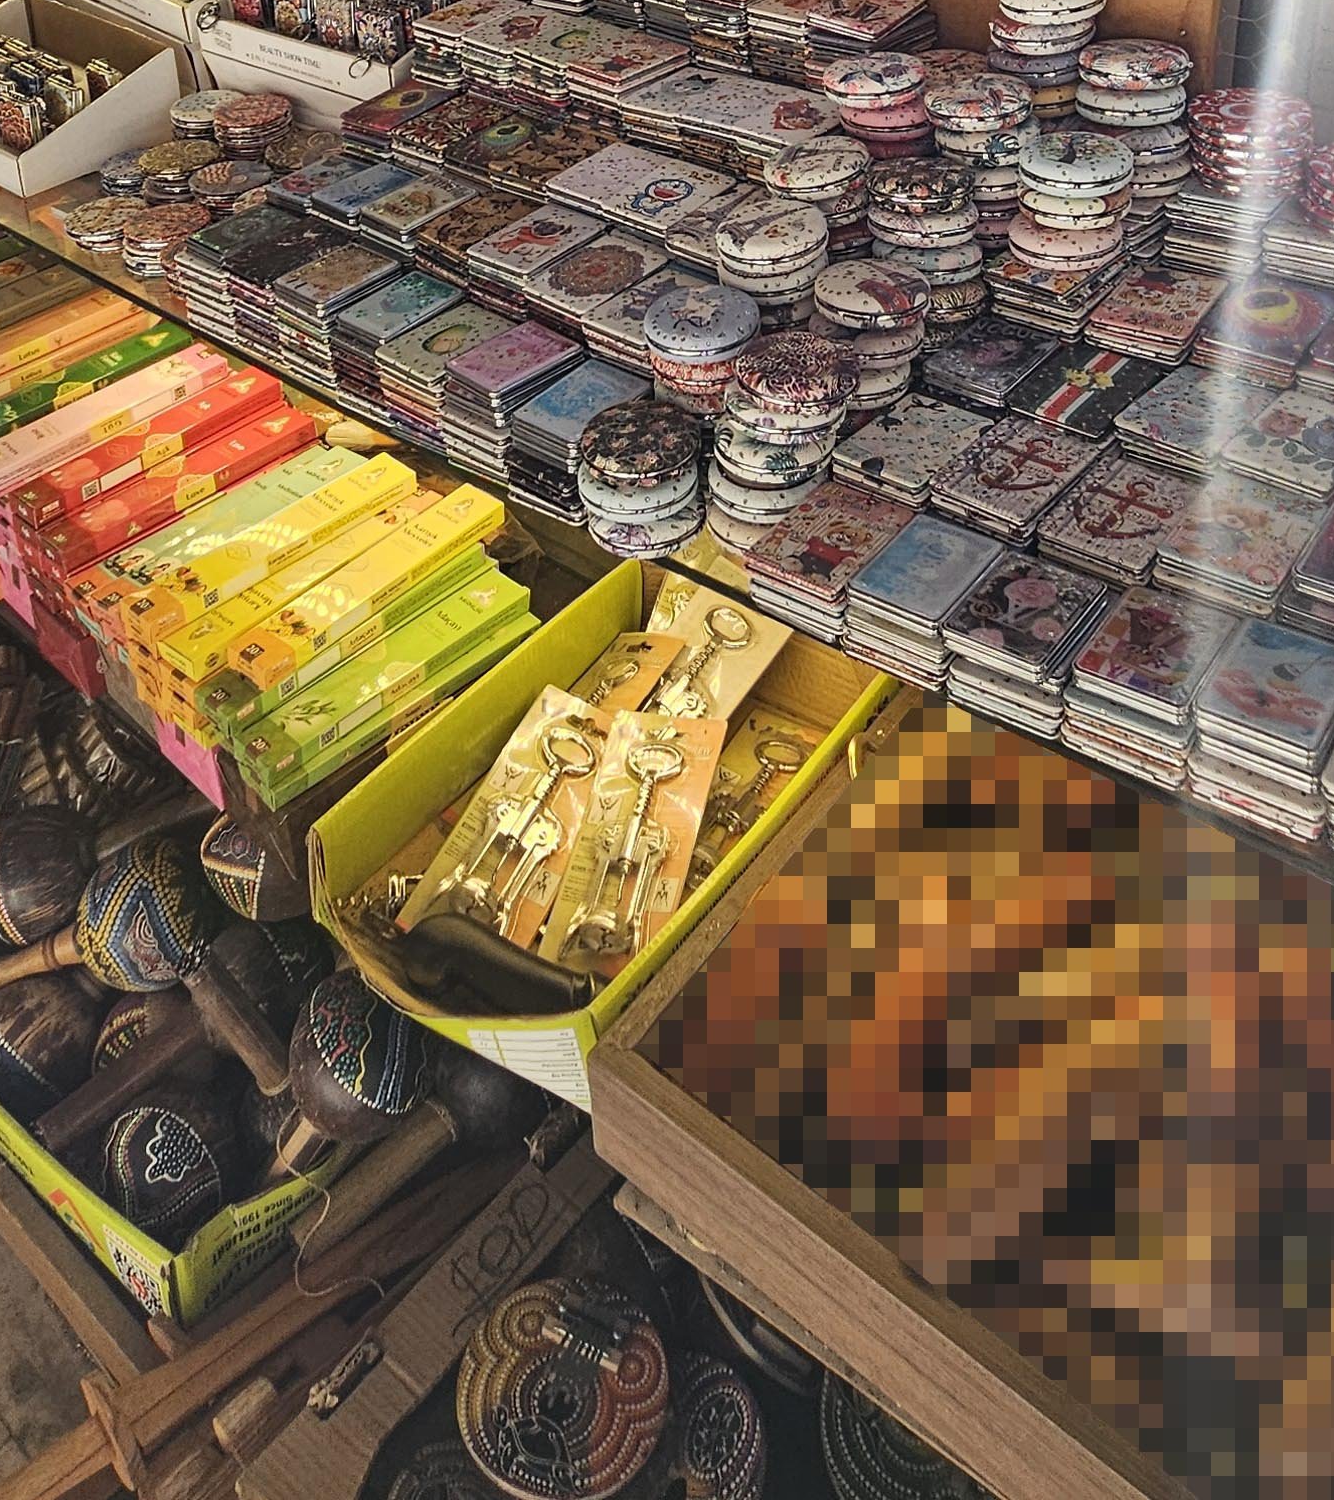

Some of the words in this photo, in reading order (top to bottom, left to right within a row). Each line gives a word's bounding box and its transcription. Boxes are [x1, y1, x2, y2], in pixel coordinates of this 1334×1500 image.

[18, 348, 41, 361] Lotus
[185, 486, 206, 501] Love
[136, 598, 150, 610] 20
[245, 643, 261, 657] 20
[211, 689, 225, 701] 20
[251, 737, 267, 750] 20
[263, 1194, 294, 1214] Since
[212, 1221, 261, 1265] DELIGHT
